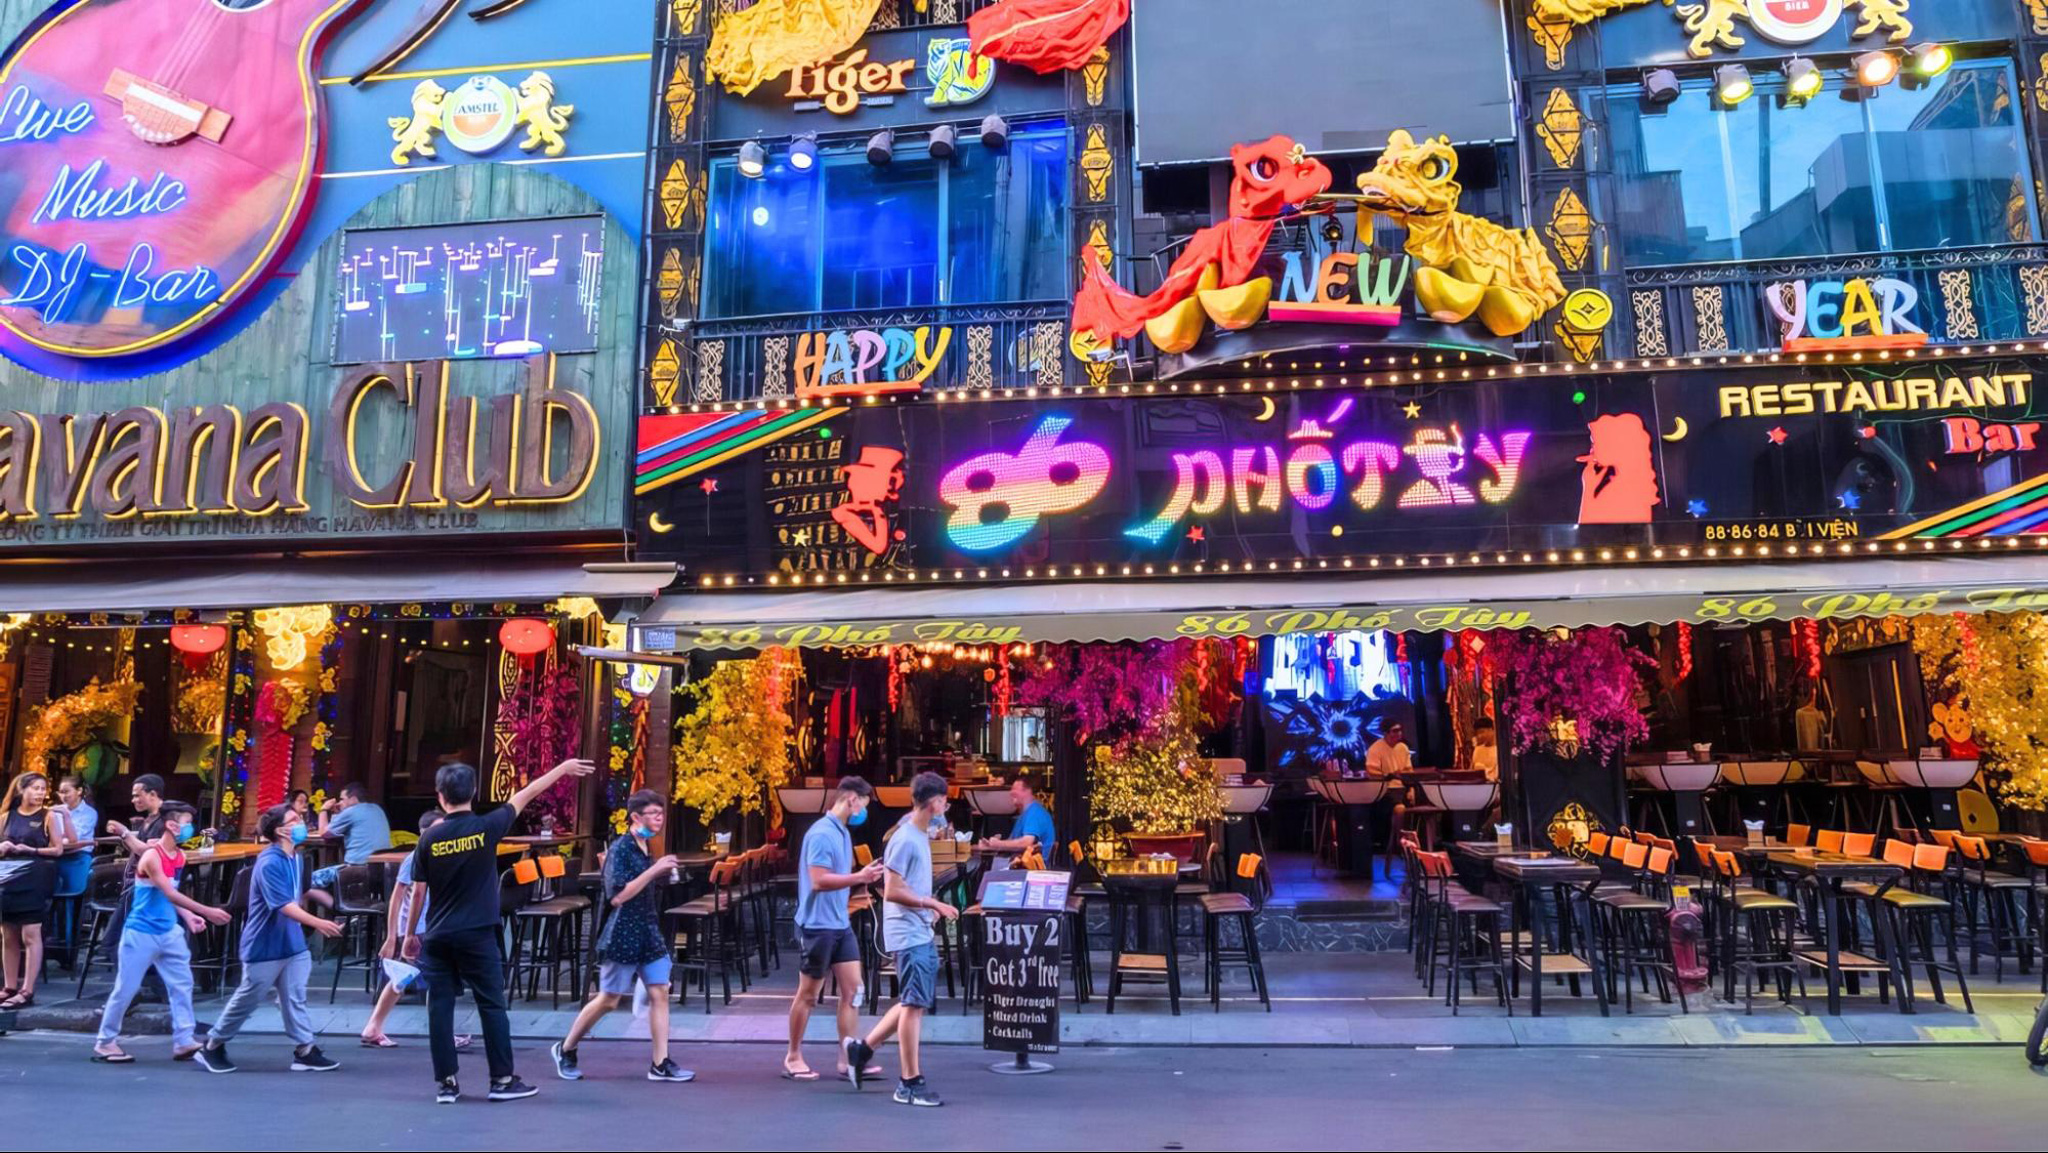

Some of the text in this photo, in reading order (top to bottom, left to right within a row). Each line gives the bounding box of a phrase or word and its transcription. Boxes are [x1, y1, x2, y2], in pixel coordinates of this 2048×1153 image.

[784, 49, 916, 114] Tiger
[0, 85, 95, 142] Live
[32, 156, 187, 224] Music
[1278, 252, 1410, 307] NEW
[1766, 279, 1926, 341] YEAR
[794, 326, 953, 386] HAPPY
[1719, 373, 2032, 418] RESTAURANT
[329, 352, 600, 509] Club
[1941, 416, 2041, 455] Bar
[939, 416, 1112, 550] 86
[426, 512, 479, 530] CLUB
[1176, 614, 1250, 634] 86
[1695, 597, 1776, 617] 86
[693, 625, 761, 646] 86
[431, 832, 485, 857] SECURITY
[985, 916, 1059, 955] Buy 2
[986, 957, 1015, 987] Get
[1038, 955, 1059, 988] free
